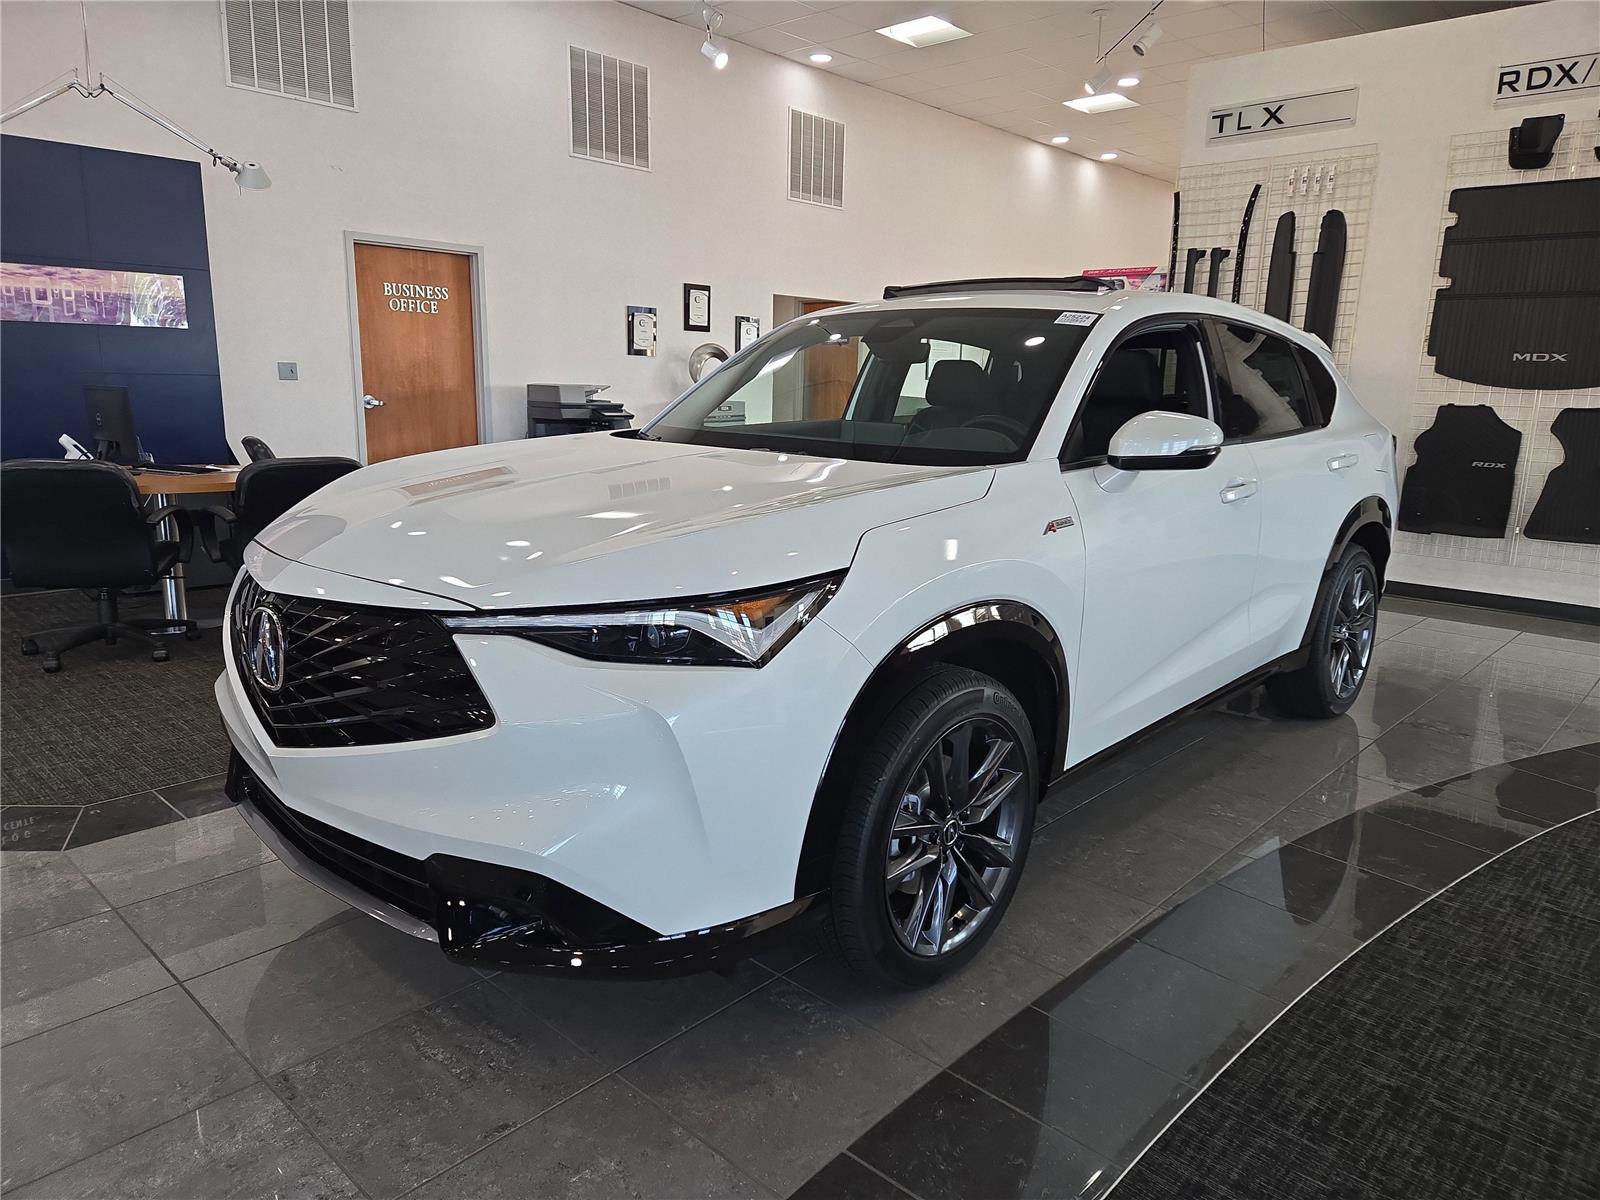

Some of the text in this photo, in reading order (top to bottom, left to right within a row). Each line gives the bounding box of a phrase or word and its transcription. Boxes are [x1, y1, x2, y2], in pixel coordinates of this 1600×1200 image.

[1211, 104, 1286, 134] TLX
[383, 282, 449, 300] BUSINESS
[389, 298, 439, 314] OFFICE
[1512, 353, 1568, 362] MDX
[1471, 461, 1507, 469] RDX
